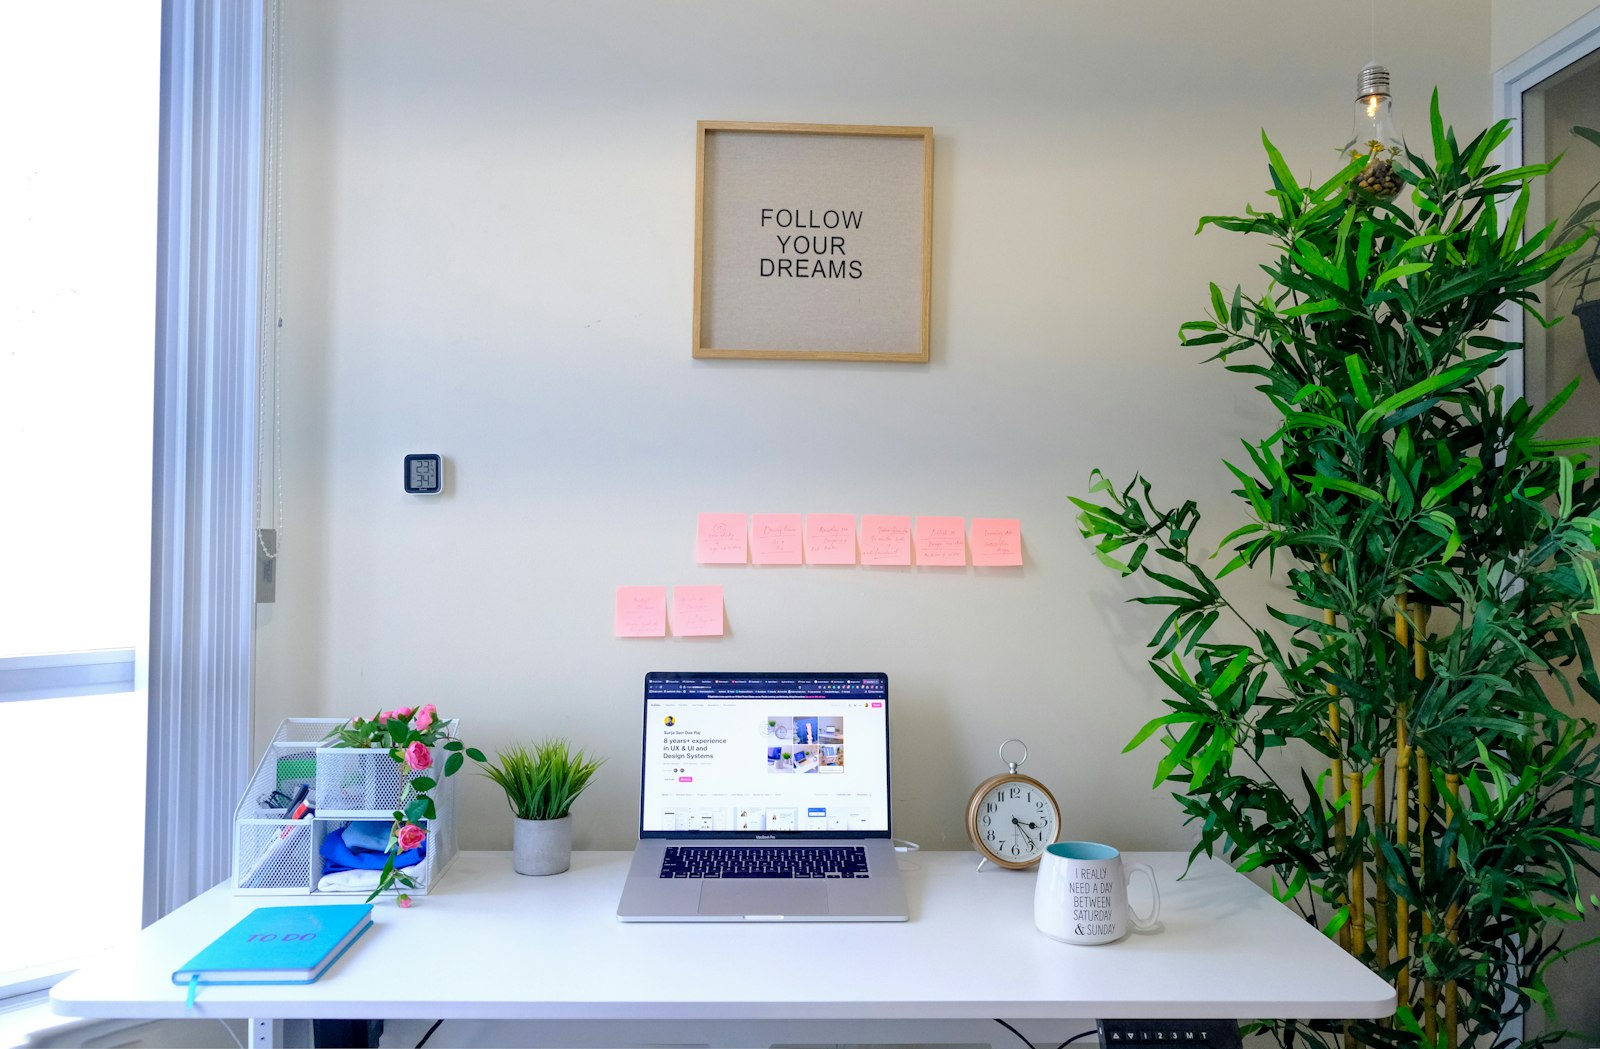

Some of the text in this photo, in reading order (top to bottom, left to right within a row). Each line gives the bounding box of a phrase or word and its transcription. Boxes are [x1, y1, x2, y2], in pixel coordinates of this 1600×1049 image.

[761, 208, 863, 229] FOLLOW
[777, 235, 845, 255] YOUR
[760, 258, 863, 279] DREAMS
[416, 460, 429, 474] 23
[416, 474, 429, 487] 34
[998, 791, 1005, 802] 11
[1010, 787, 1021, 799] 12
[987, 801, 998, 813] 10
[1036, 801, 1044, 813] 2
[983, 815, 991, 826] 9
[987, 830, 996, 842] 8
[999, 840, 1005, 851] 7
[1011, 844, 1020, 856] 6
[1025, 840, 1034, 852] 5
[1081, 868, 1107, 880] REALLY
[1069, 882, 1113, 894] NEED A DAY
[1073, 896, 1111, 908] BETWEEN
[1073, 909, 1112, 921] SATURDAY
[1074, 922, 1116, 936] & SUNDAY
[248, 933, 316, 942] TO DO
